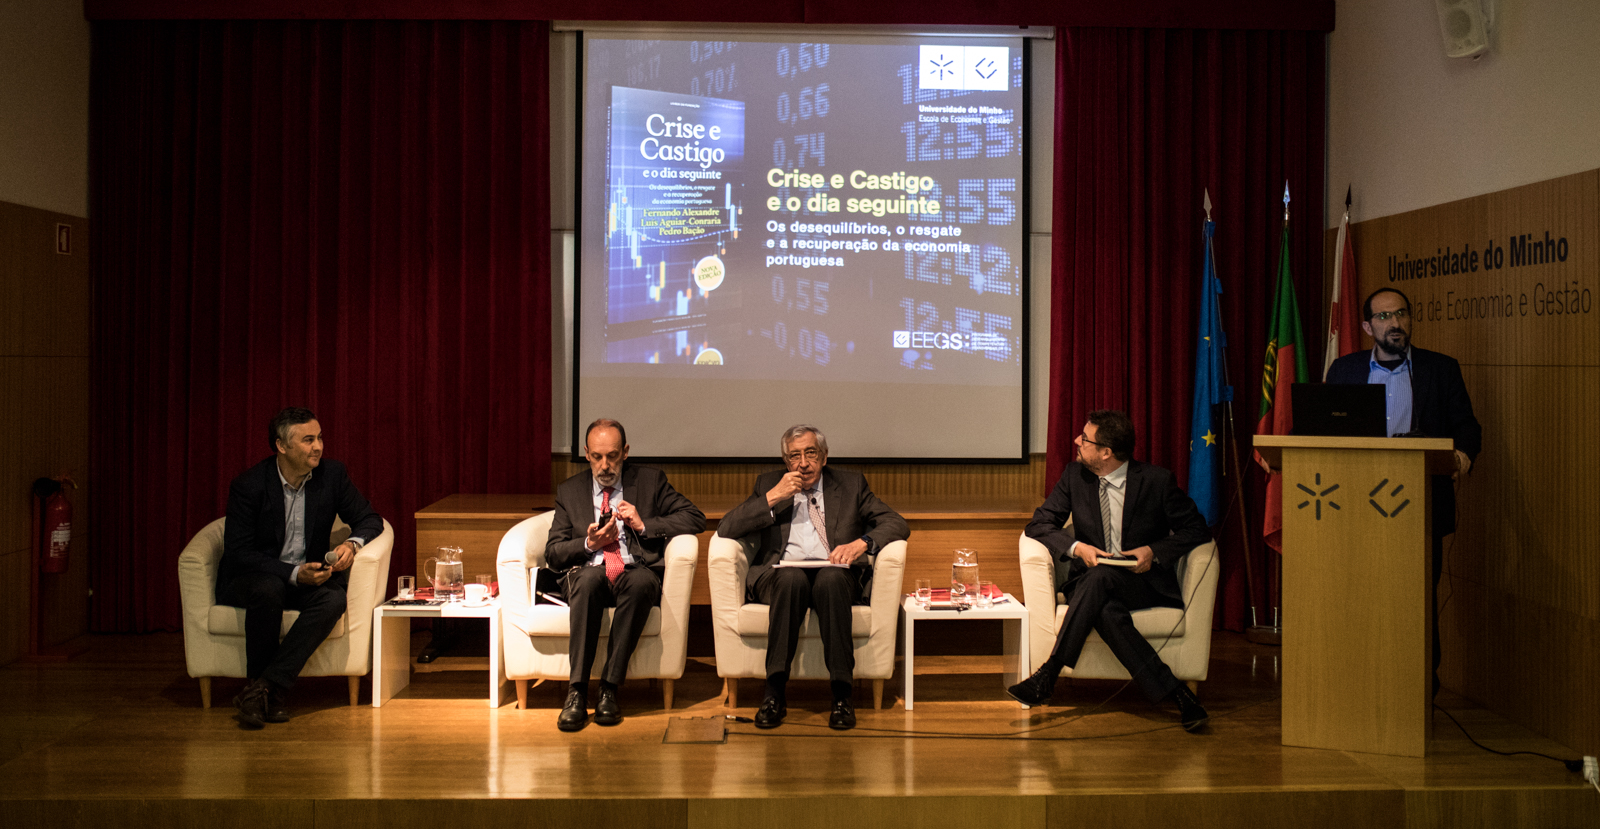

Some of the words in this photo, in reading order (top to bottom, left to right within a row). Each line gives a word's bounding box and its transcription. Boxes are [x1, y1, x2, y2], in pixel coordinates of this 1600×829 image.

[776, 83, 830, 124] 0,66
[919, 105, 966, 114] Universidade
[968, 106, 978, 114] do
[979, 106, 1003, 115] Minho
[646, 113, 705, 139] Crise
[709, 125, 721, 140] e
[919, 115, 939, 123] Escola
[941, 115, 949, 123] de
[640, 137, 725, 169] Castigo
[642, 169, 650, 178] e
[651, 169, 658, 178] o
[660, 167, 678, 178] dia
[679, 169, 722, 182] seguinte
[767, 168, 825, 188] Crise
[830, 174, 845, 189] e
[850, 170, 934, 194] Castigo
[643, 209, 681, 217] Fernando
[682, 208, 720, 217] Alexandre
[767, 196, 781, 211] e
[786, 196, 801, 211] o
[807, 193, 840, 212] dia
[847, 195, 941, 217] seguinte
[659, 217, 721, 229] Aguiar-Conraria
[766, 220, 786, 232] Os
[790, 222, 892, 237] desequilíbrios,
[896, 226, 905, 236] o
[910, 226, 962, 238] resgate
[659, 228, 681, 236] Pedro
[682, 227, 705, 238] Bação
[766, 239, 775, 248] e
[779, 239, 788, 249] a
[792, 239, 878, 253] recuperação
[882, 240, 900, 251] da
[904, 242, 971, 253] economia
[766, 255, 844, 268] portuguesa
[1389, 244, 1478, 282] Universidade
[1484, 240, 1503, 271] do
[1510, 231, 1568, 267] Minho
[701, 266, 718, 274] NOVA
[772, 274, 829, 316] 0,55
[1427, 294, 1442, 321] de
[1447, 288, 1513, 320] Economia
[1520, 293, 1528, 316] e
[1534, 281, 1591, 316] Gestão
